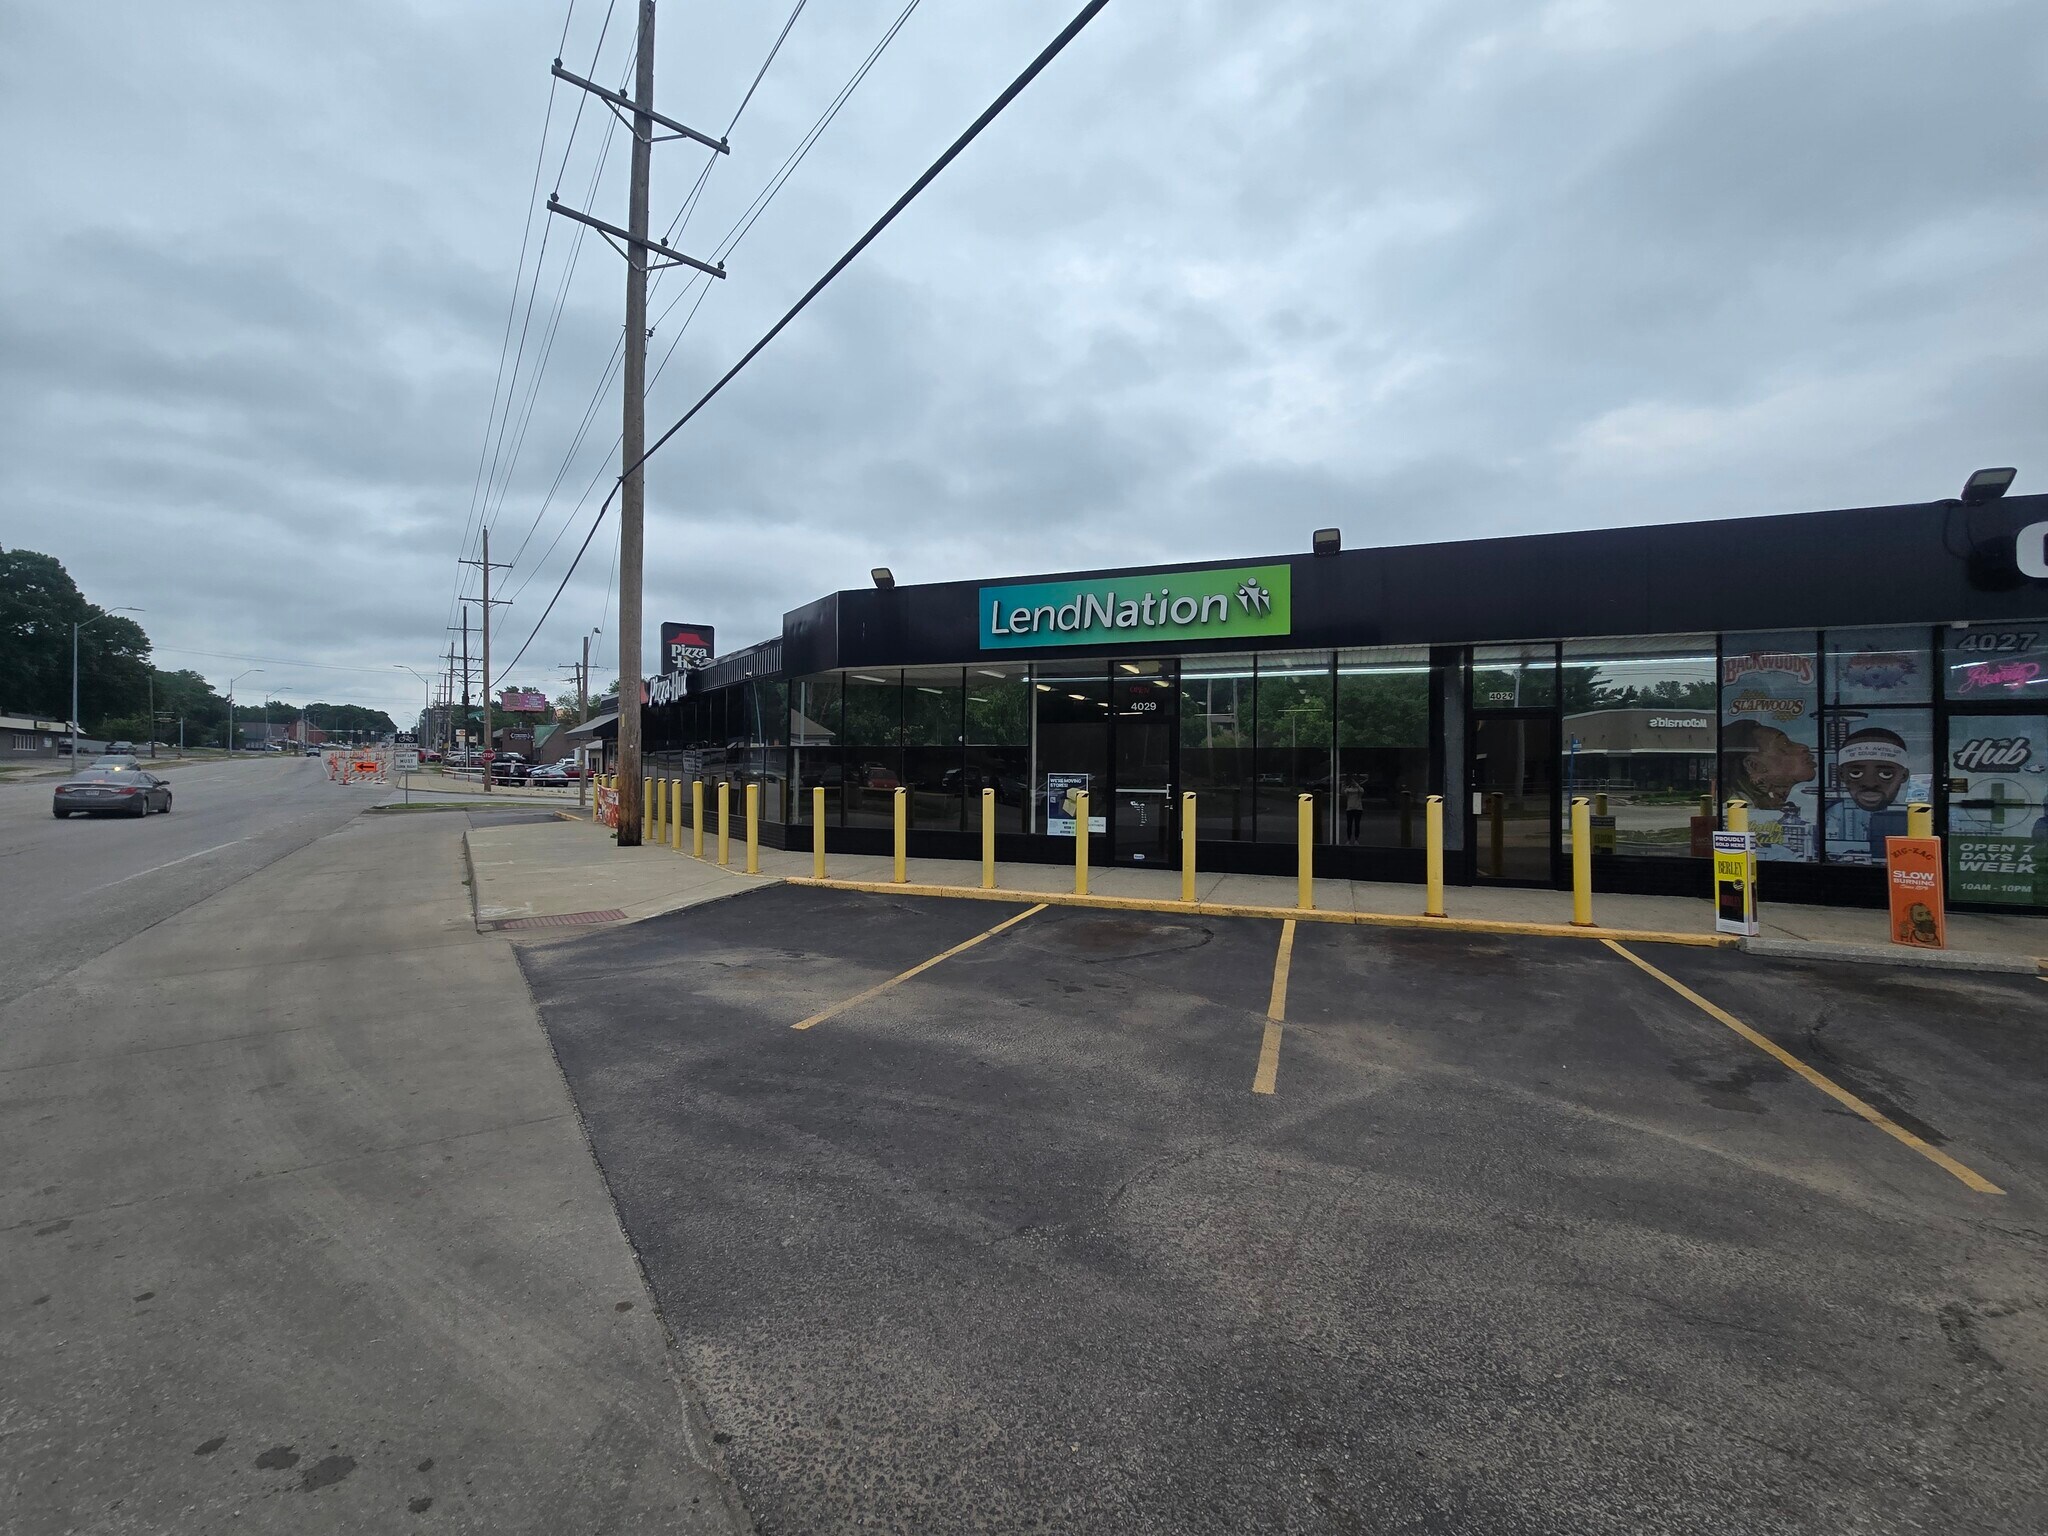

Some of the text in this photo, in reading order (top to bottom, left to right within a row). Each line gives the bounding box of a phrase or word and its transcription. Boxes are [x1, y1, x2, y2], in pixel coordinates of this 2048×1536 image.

[991, 588, 1228, 634] LendNation
[1958, 632, 2038, 652] 4027
[671, 644, 707, 658] Pizza
[671, 655, 701, 669] Ht
[1724, 652, 1813, 683] BACKWOODS
[648, 670, 687, 707] Pizza Hut
[1490, 692, 1513, 700] 4029
[1131, 702, 1157, 710] 4029
[1729, 699, 1804, 716] SLAPWOODS
[1956, 738, 2029, 769] Hub
[1891, 847, 1936, 860] ZIG-ZAG
[1960, 843, 2035, 853] OPEN 7
[1961, 852, 2033, 862] DAYS A
[1718, 861, 1743, 877] BERLEY
[1960, 861, 2037, 874] WEEK
[1893, 870, 1935, 880] SLOW
[1893, 878, 1935, 887] BURNING
[1961, 883, 1991, 891] 10AM
[2001, 884, 2032, 892] 10PM
